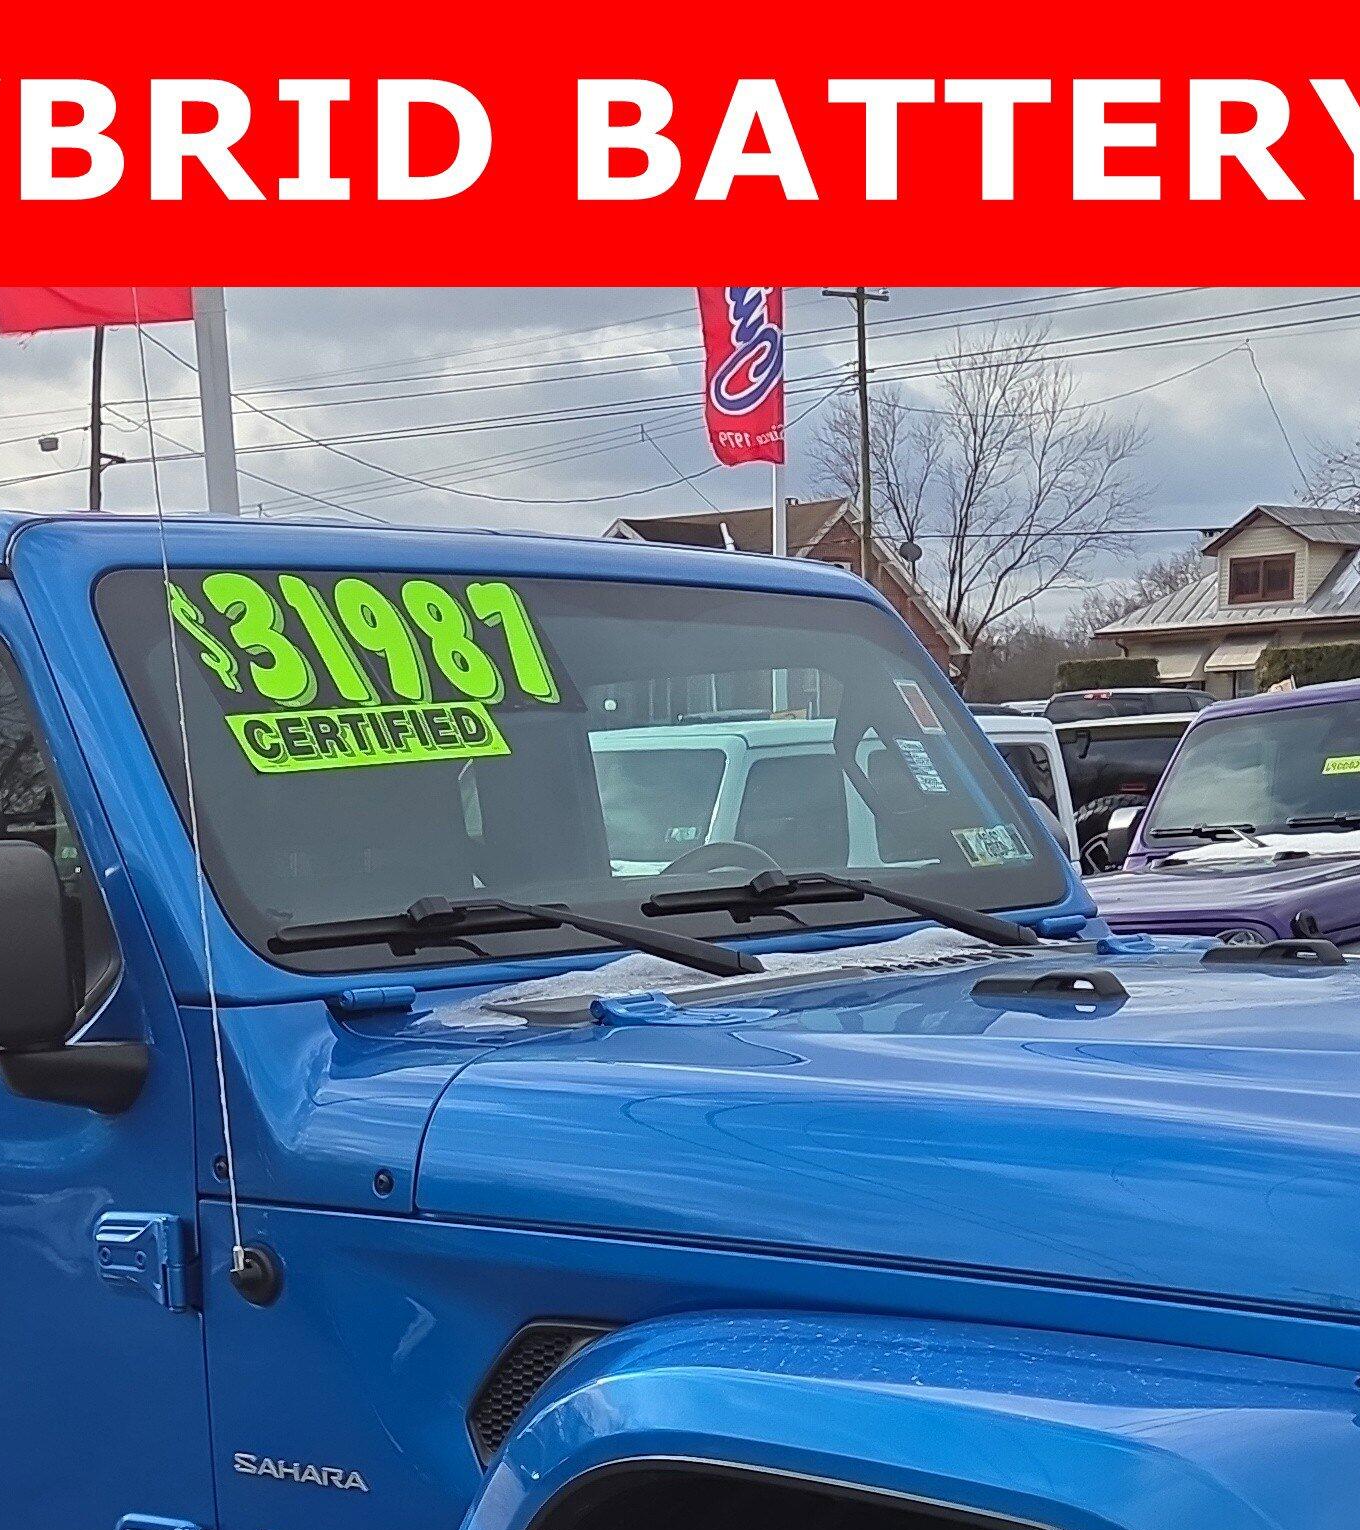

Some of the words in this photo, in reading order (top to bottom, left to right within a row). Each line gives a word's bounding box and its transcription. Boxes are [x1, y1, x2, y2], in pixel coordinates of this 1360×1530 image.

[167, 572, 560, 705] $31987
[243, 706, 493, 763] CERTIFIED
[233, 1452, 370, 1493] SAHARA
